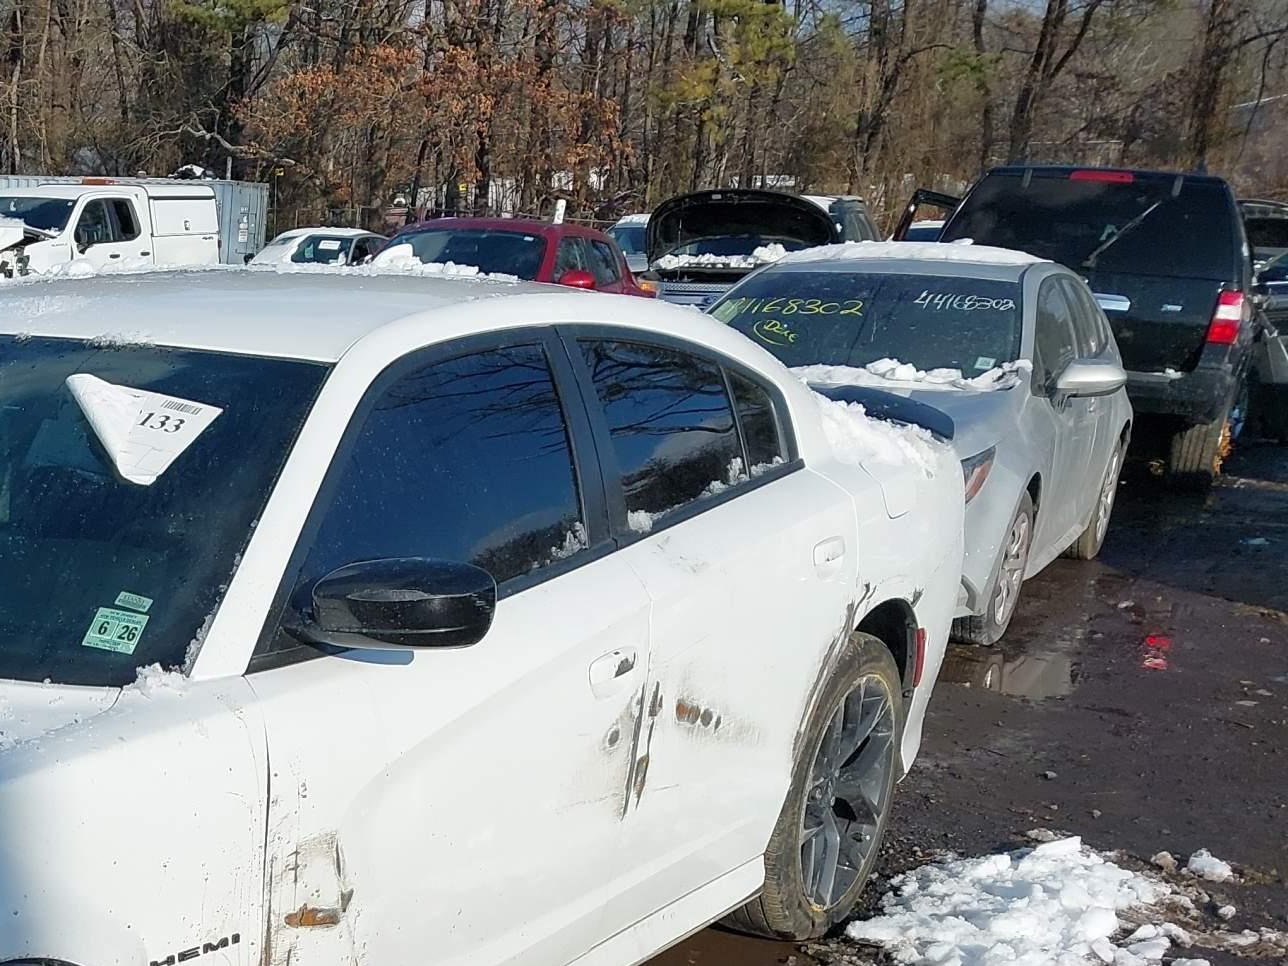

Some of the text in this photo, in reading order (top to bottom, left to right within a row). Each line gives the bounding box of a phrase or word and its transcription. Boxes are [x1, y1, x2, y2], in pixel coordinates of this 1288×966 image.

[913, 289, 1016, 311] 44168302
[138, 411, 186, 434] 133
[98, 621, 138, 642] 6 26
